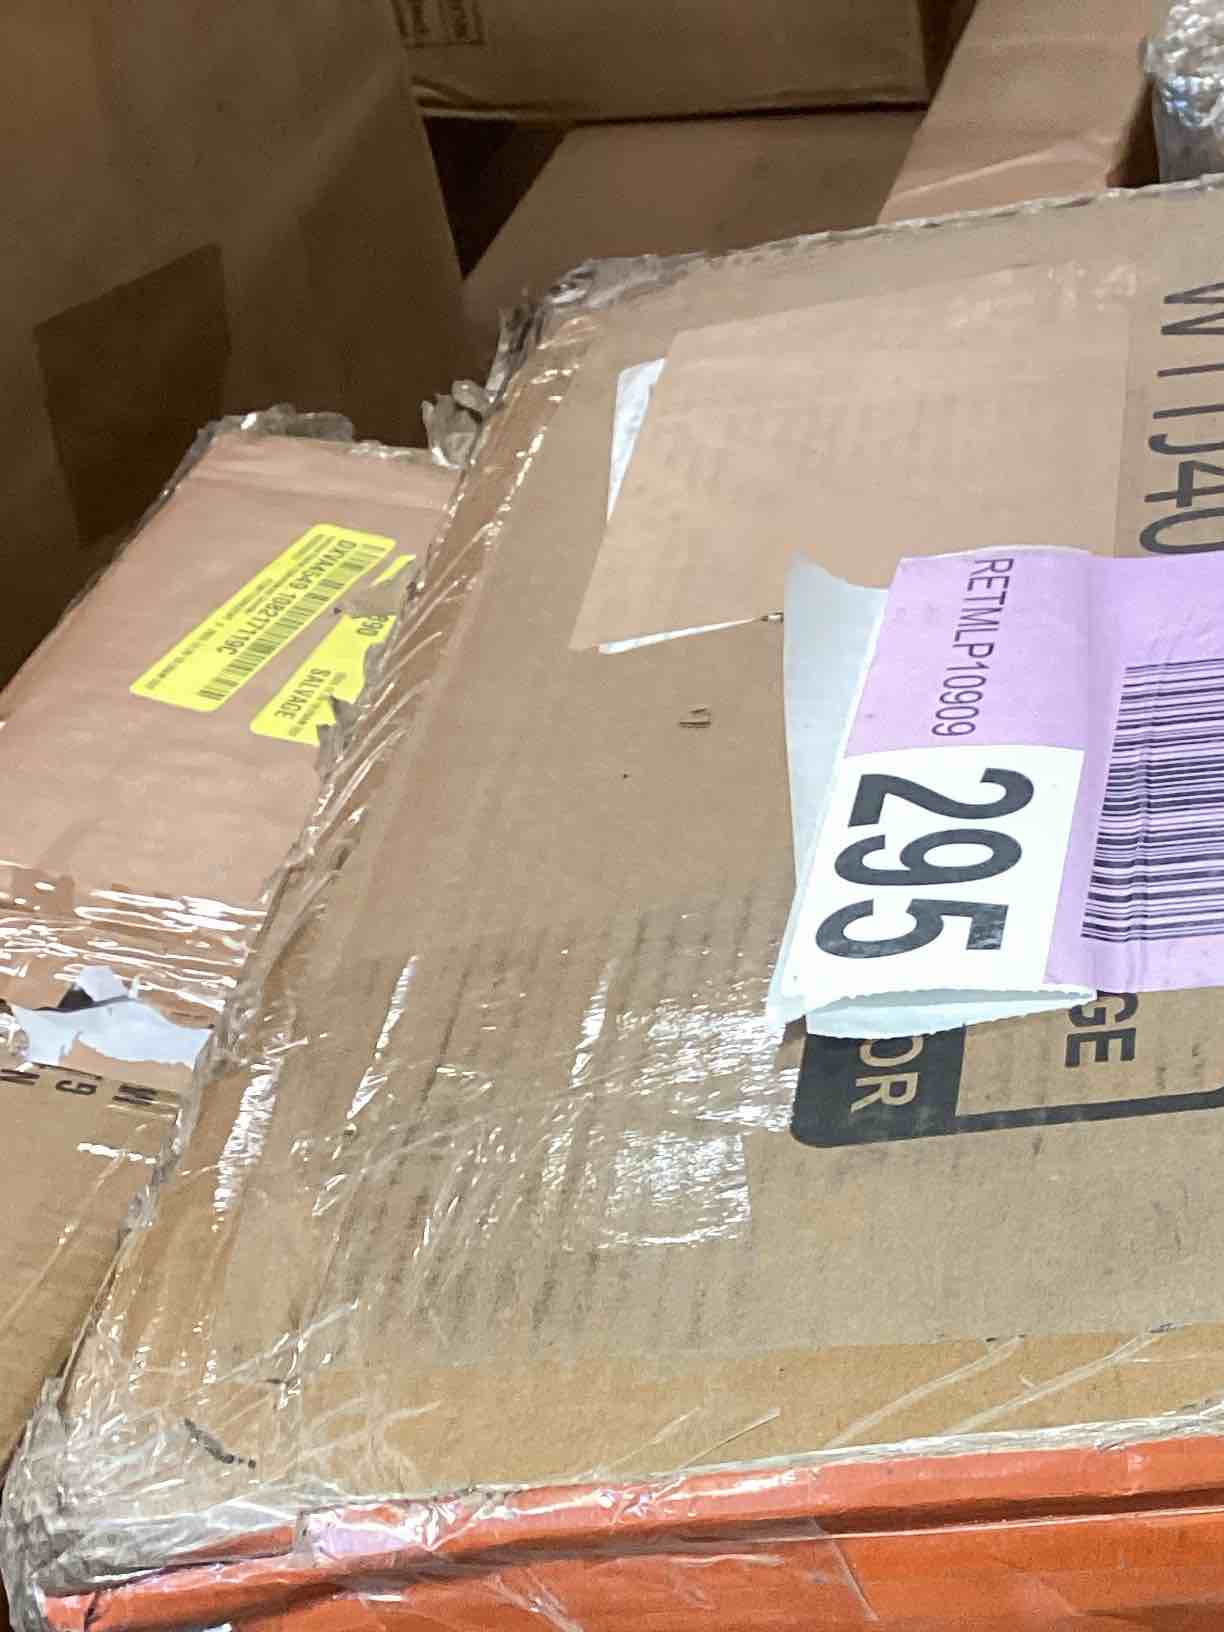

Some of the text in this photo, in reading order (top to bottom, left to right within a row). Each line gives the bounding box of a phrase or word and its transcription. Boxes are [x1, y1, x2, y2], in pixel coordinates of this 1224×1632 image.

[273, 667, 331, 720] SALVAGE
[930, 556, 1014, 738] RETMLP10909
[814, 766, 1036, 960] 295
